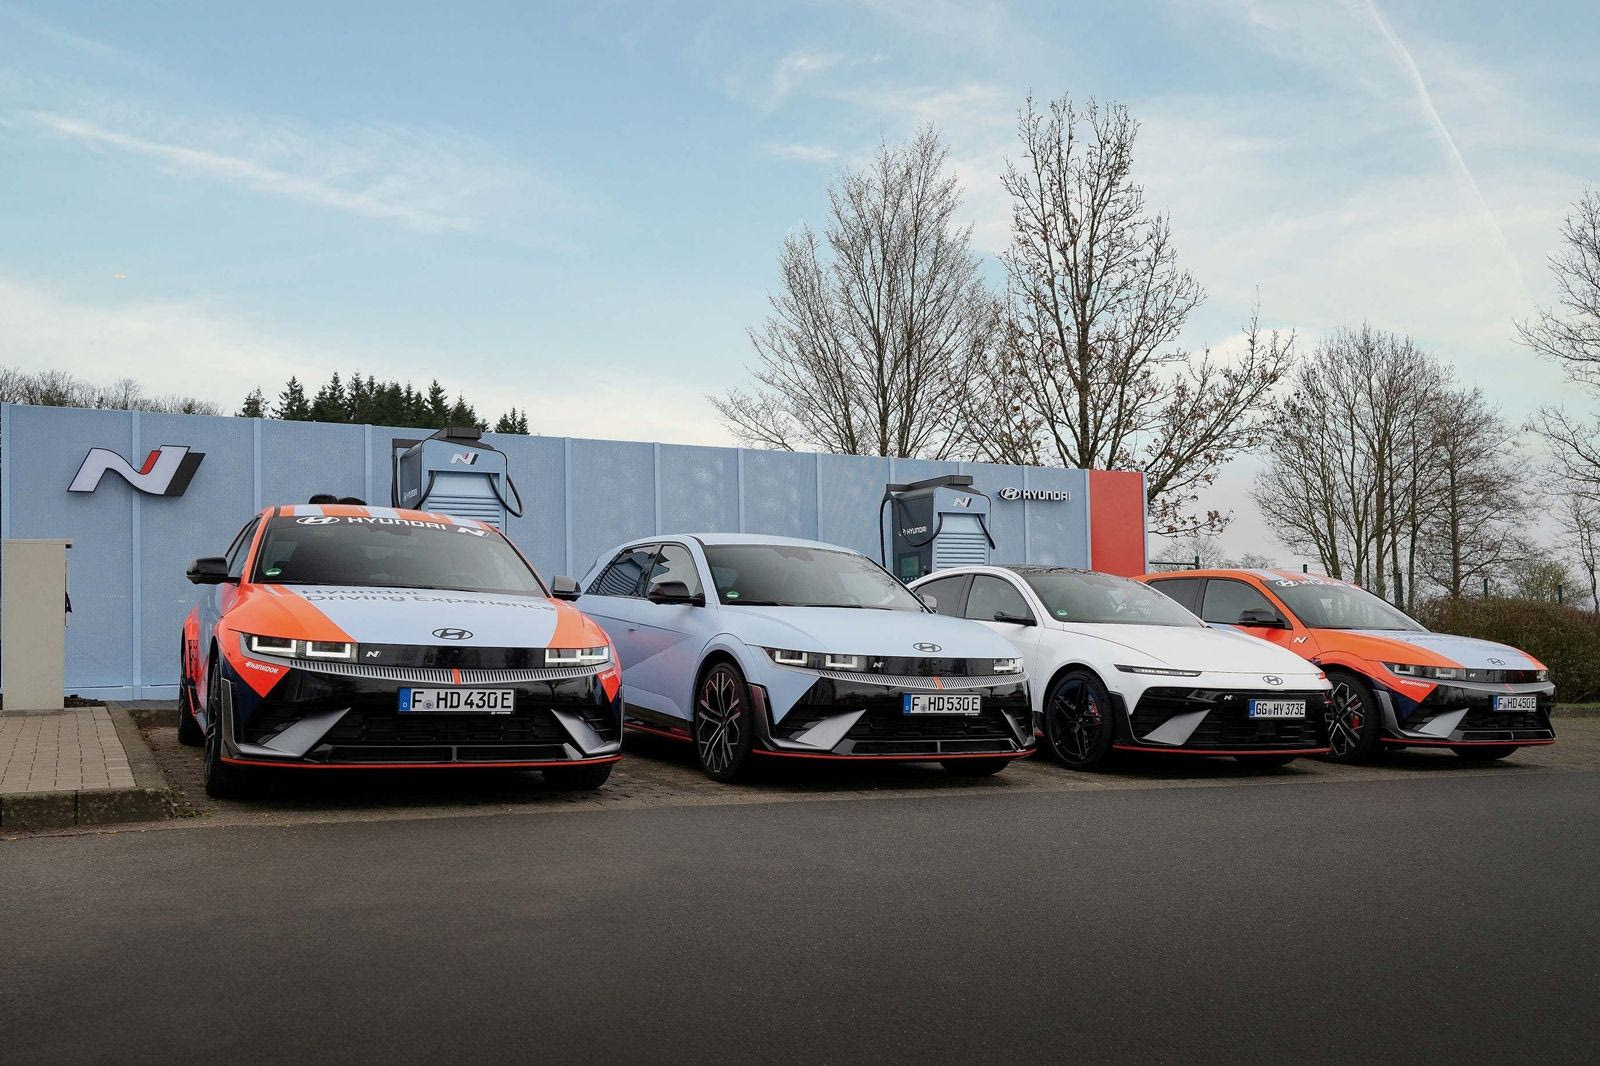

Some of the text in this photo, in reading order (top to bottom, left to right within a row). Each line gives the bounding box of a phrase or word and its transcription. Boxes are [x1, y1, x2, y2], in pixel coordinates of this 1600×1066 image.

[1022, 489, 1071, 501] HYUNDAI
[348, 516, 447, 531] HYUNDAI
[306, 594, 556, 611] Driving Experience
[1255, 702, 1268, 716] GG
